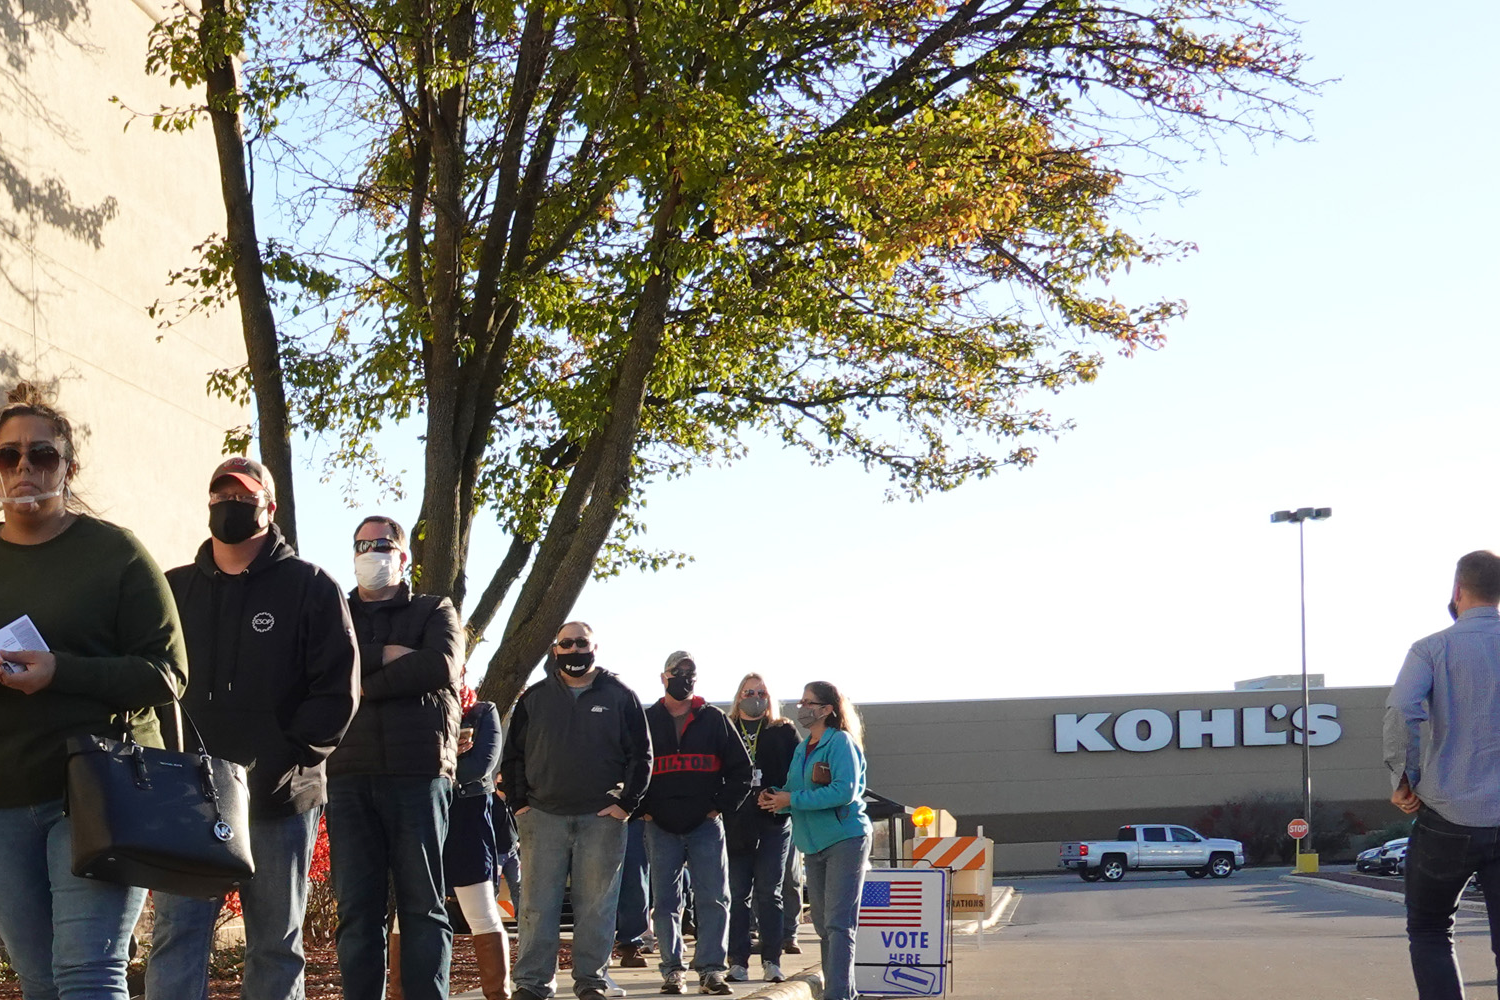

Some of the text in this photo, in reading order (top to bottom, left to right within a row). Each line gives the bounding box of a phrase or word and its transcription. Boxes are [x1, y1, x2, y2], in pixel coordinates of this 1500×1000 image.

[1054, 702, 1342, 753] KOHL'S
[1289, 824, 1307, 833] STOP
[880, 930, 929, 949] VOTE
